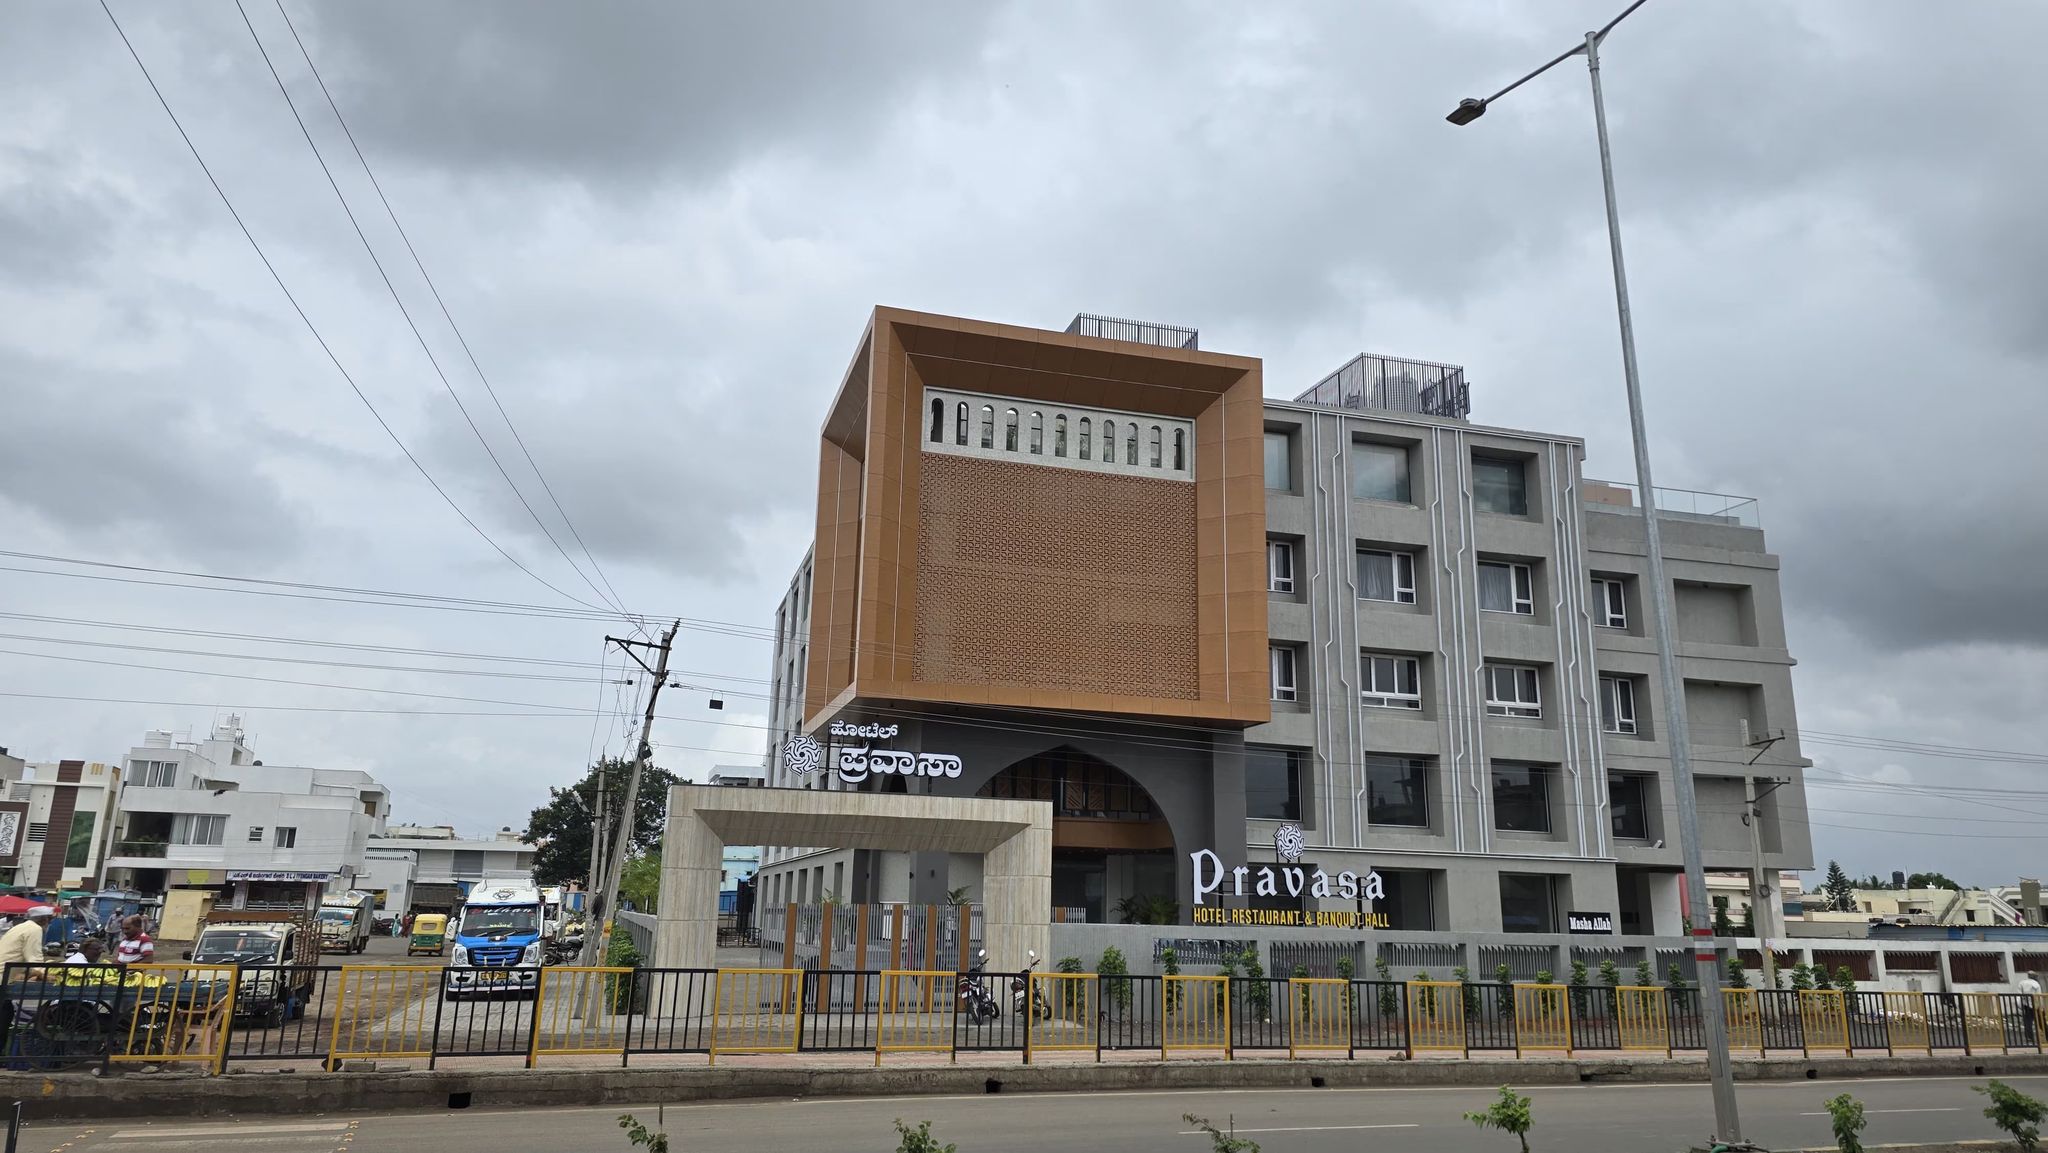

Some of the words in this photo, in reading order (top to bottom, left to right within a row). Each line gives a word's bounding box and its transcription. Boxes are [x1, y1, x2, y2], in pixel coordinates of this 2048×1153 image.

[830, 719, 898, 739] ಹೋಟೆಲ್
[839, 741, 963, 784] ಪ್ರವಾಸಾ
[1190, 848, 1386, 905] Pravasa
[1193, 907, 1228, 924] HOTEL
[1232, 908, 1300, 926] RESTAURANT
[1305, 911, 1313, 925] &
[1316, 911, 1362, 929] BANQUET
[1365, 912, 1390, 928] HALL
[1569, 916, 1593, 930] Masha
[1593, 917, 1612, 931] Allah
